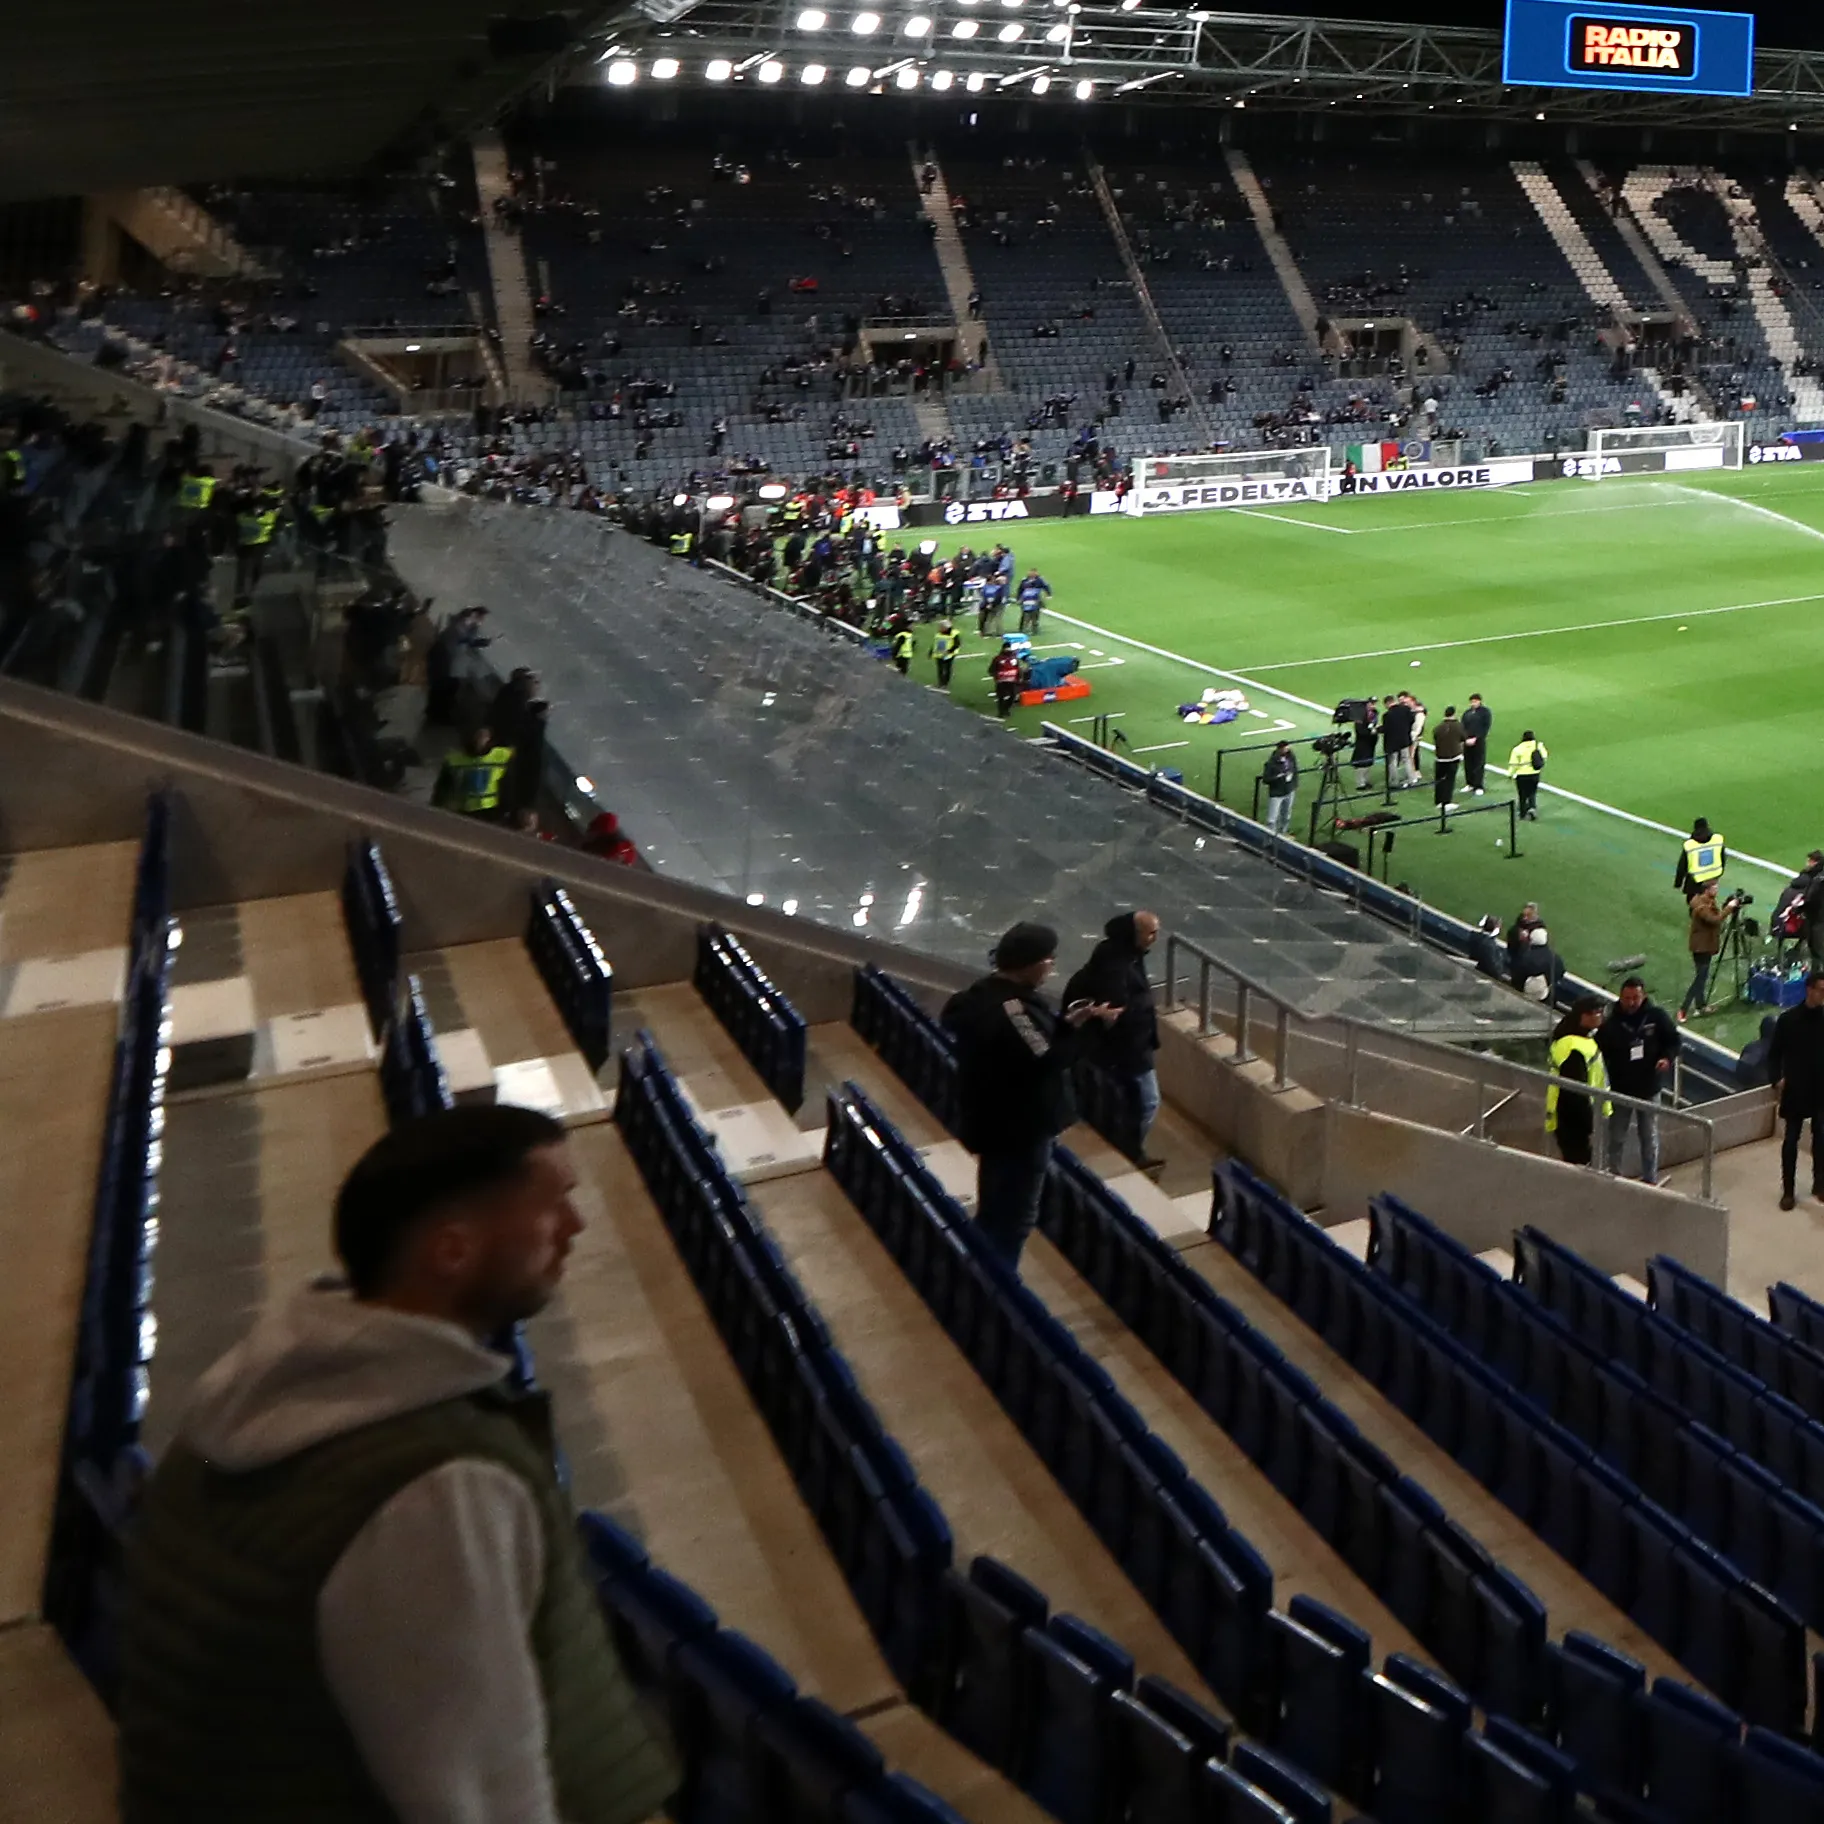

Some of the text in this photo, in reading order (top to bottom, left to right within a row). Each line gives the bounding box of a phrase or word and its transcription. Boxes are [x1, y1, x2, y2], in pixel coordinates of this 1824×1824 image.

[1585, 25, 1681, 48] RADIO
[1584, 47, 1680, 69] ITALIA
[1386, 467, 1491, 489] VALORE
